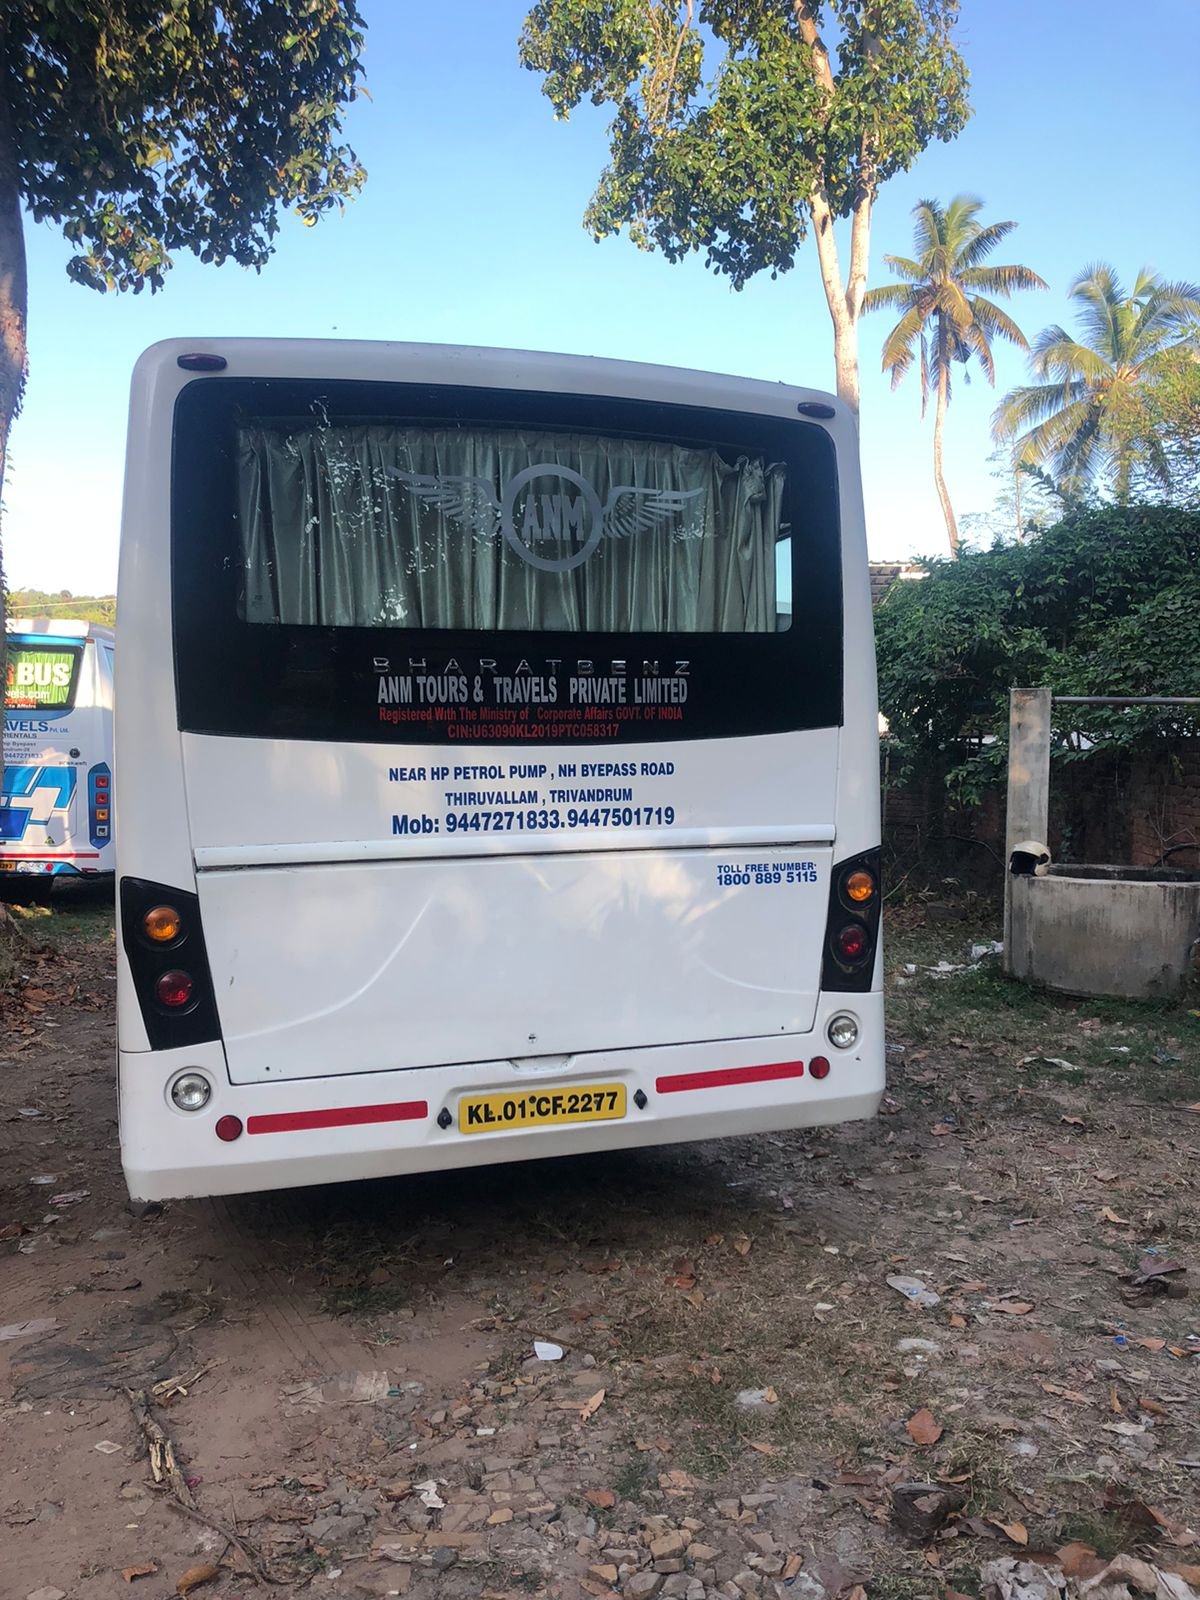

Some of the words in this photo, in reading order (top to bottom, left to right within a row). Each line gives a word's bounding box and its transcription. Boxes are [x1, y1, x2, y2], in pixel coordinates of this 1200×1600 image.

[521, 494, 585, 541] ANM
[17, 662, 71, 687] BUS
[373, 657, 690, 675] BHARATBENZ
[377, 676, 412, 703] ANM
[416, 675, 468, 703] TOURS
[473, 675, 484, 702] &
[493, 676, 557, 703] TRAVELS
[569, 677, 626, 704] PRIVATE
[634, 677, 688, 704] LIMITED
[379, 707, 432, 723] Registered
[433, 707, 456, 721] With
[459, 707, 477, 720] The
[480, 707, 516, 723] Ministry
[519, 706, 529, 720] of
[537, 707, 582, 721] Corporate
[584, 706, 614, 720] Affairs
[616, 706, 641, 720] GOVT.
[644, 706, 656, 719] OF
[658, 706, 683, 720] INDIA
[447, 723, 620, 738] CIN:U63090KL2019PTC058317
[389, 767, 427, 781] NEAR
[431, 767, 450, 781] HP
[454, 765, 505, 780] PETROL
[509, 764, 547, 779] PUMP
[558, 763, 577, 778] NH
[581, 762, 637, 777] BYEPASS
[640, 762, 675, 776] ROAD
[445, 790, 538, 806] THIRUVALLAM
[549, 788, 633, 803] TRIVANDRUM
[392, 814, 439, 834] Mob:
[717, 865, 742, 873] TOLL
[745, 863, 769, 872] FREE
[717, 873, 750, 886] 1800
[755, 872, 781, 884] 889
[786, 871, 817, 883] 5115
